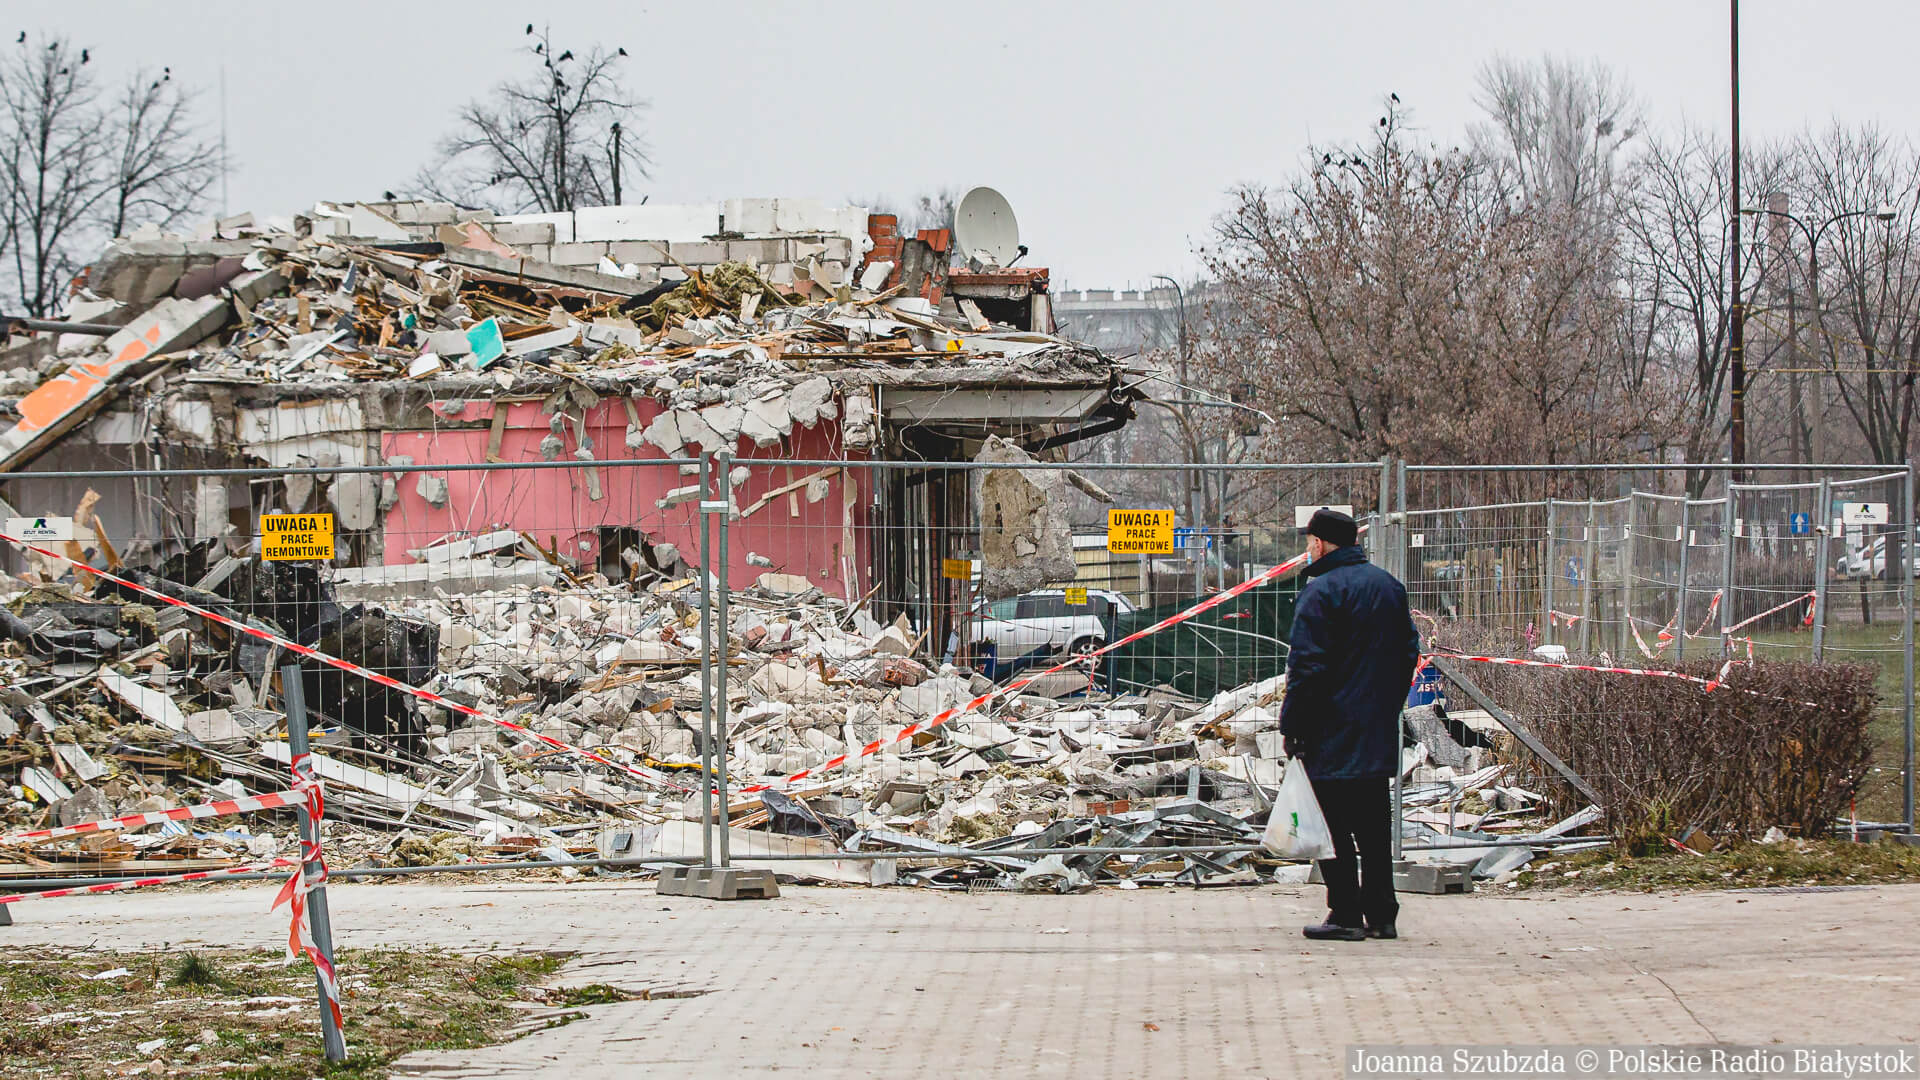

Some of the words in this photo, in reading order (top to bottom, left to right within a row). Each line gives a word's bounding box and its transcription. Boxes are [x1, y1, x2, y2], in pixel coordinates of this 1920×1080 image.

[266, 517, 318, 532] UWAGA
[1114, 513, 1160, 526] UWAGA
[281, 534, 314, 544] PRACE
[1126, 528, 1156, 539] PRACE
[266, 545, 330, 557] REMONTOWE
[1111, 540, 1169, 551] REMONTOWE
